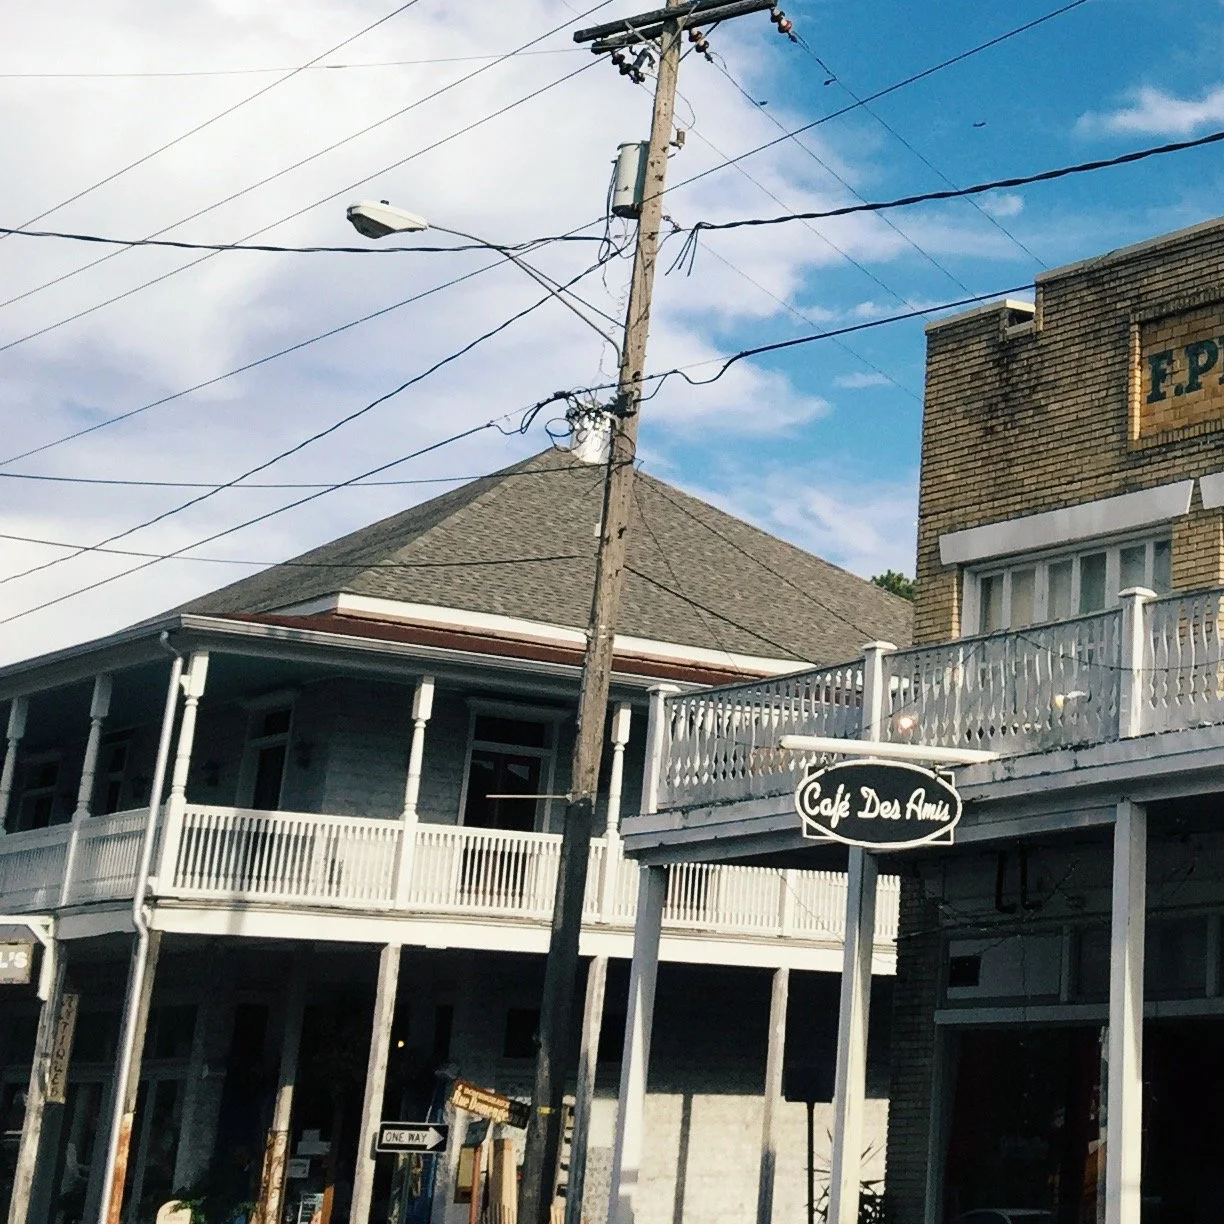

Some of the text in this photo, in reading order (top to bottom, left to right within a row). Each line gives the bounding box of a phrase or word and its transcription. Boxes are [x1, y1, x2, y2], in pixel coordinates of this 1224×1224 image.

[804, 781, 951, 829] Café Des Amis
[385, 1131, 427, 1143] ONE WAY
